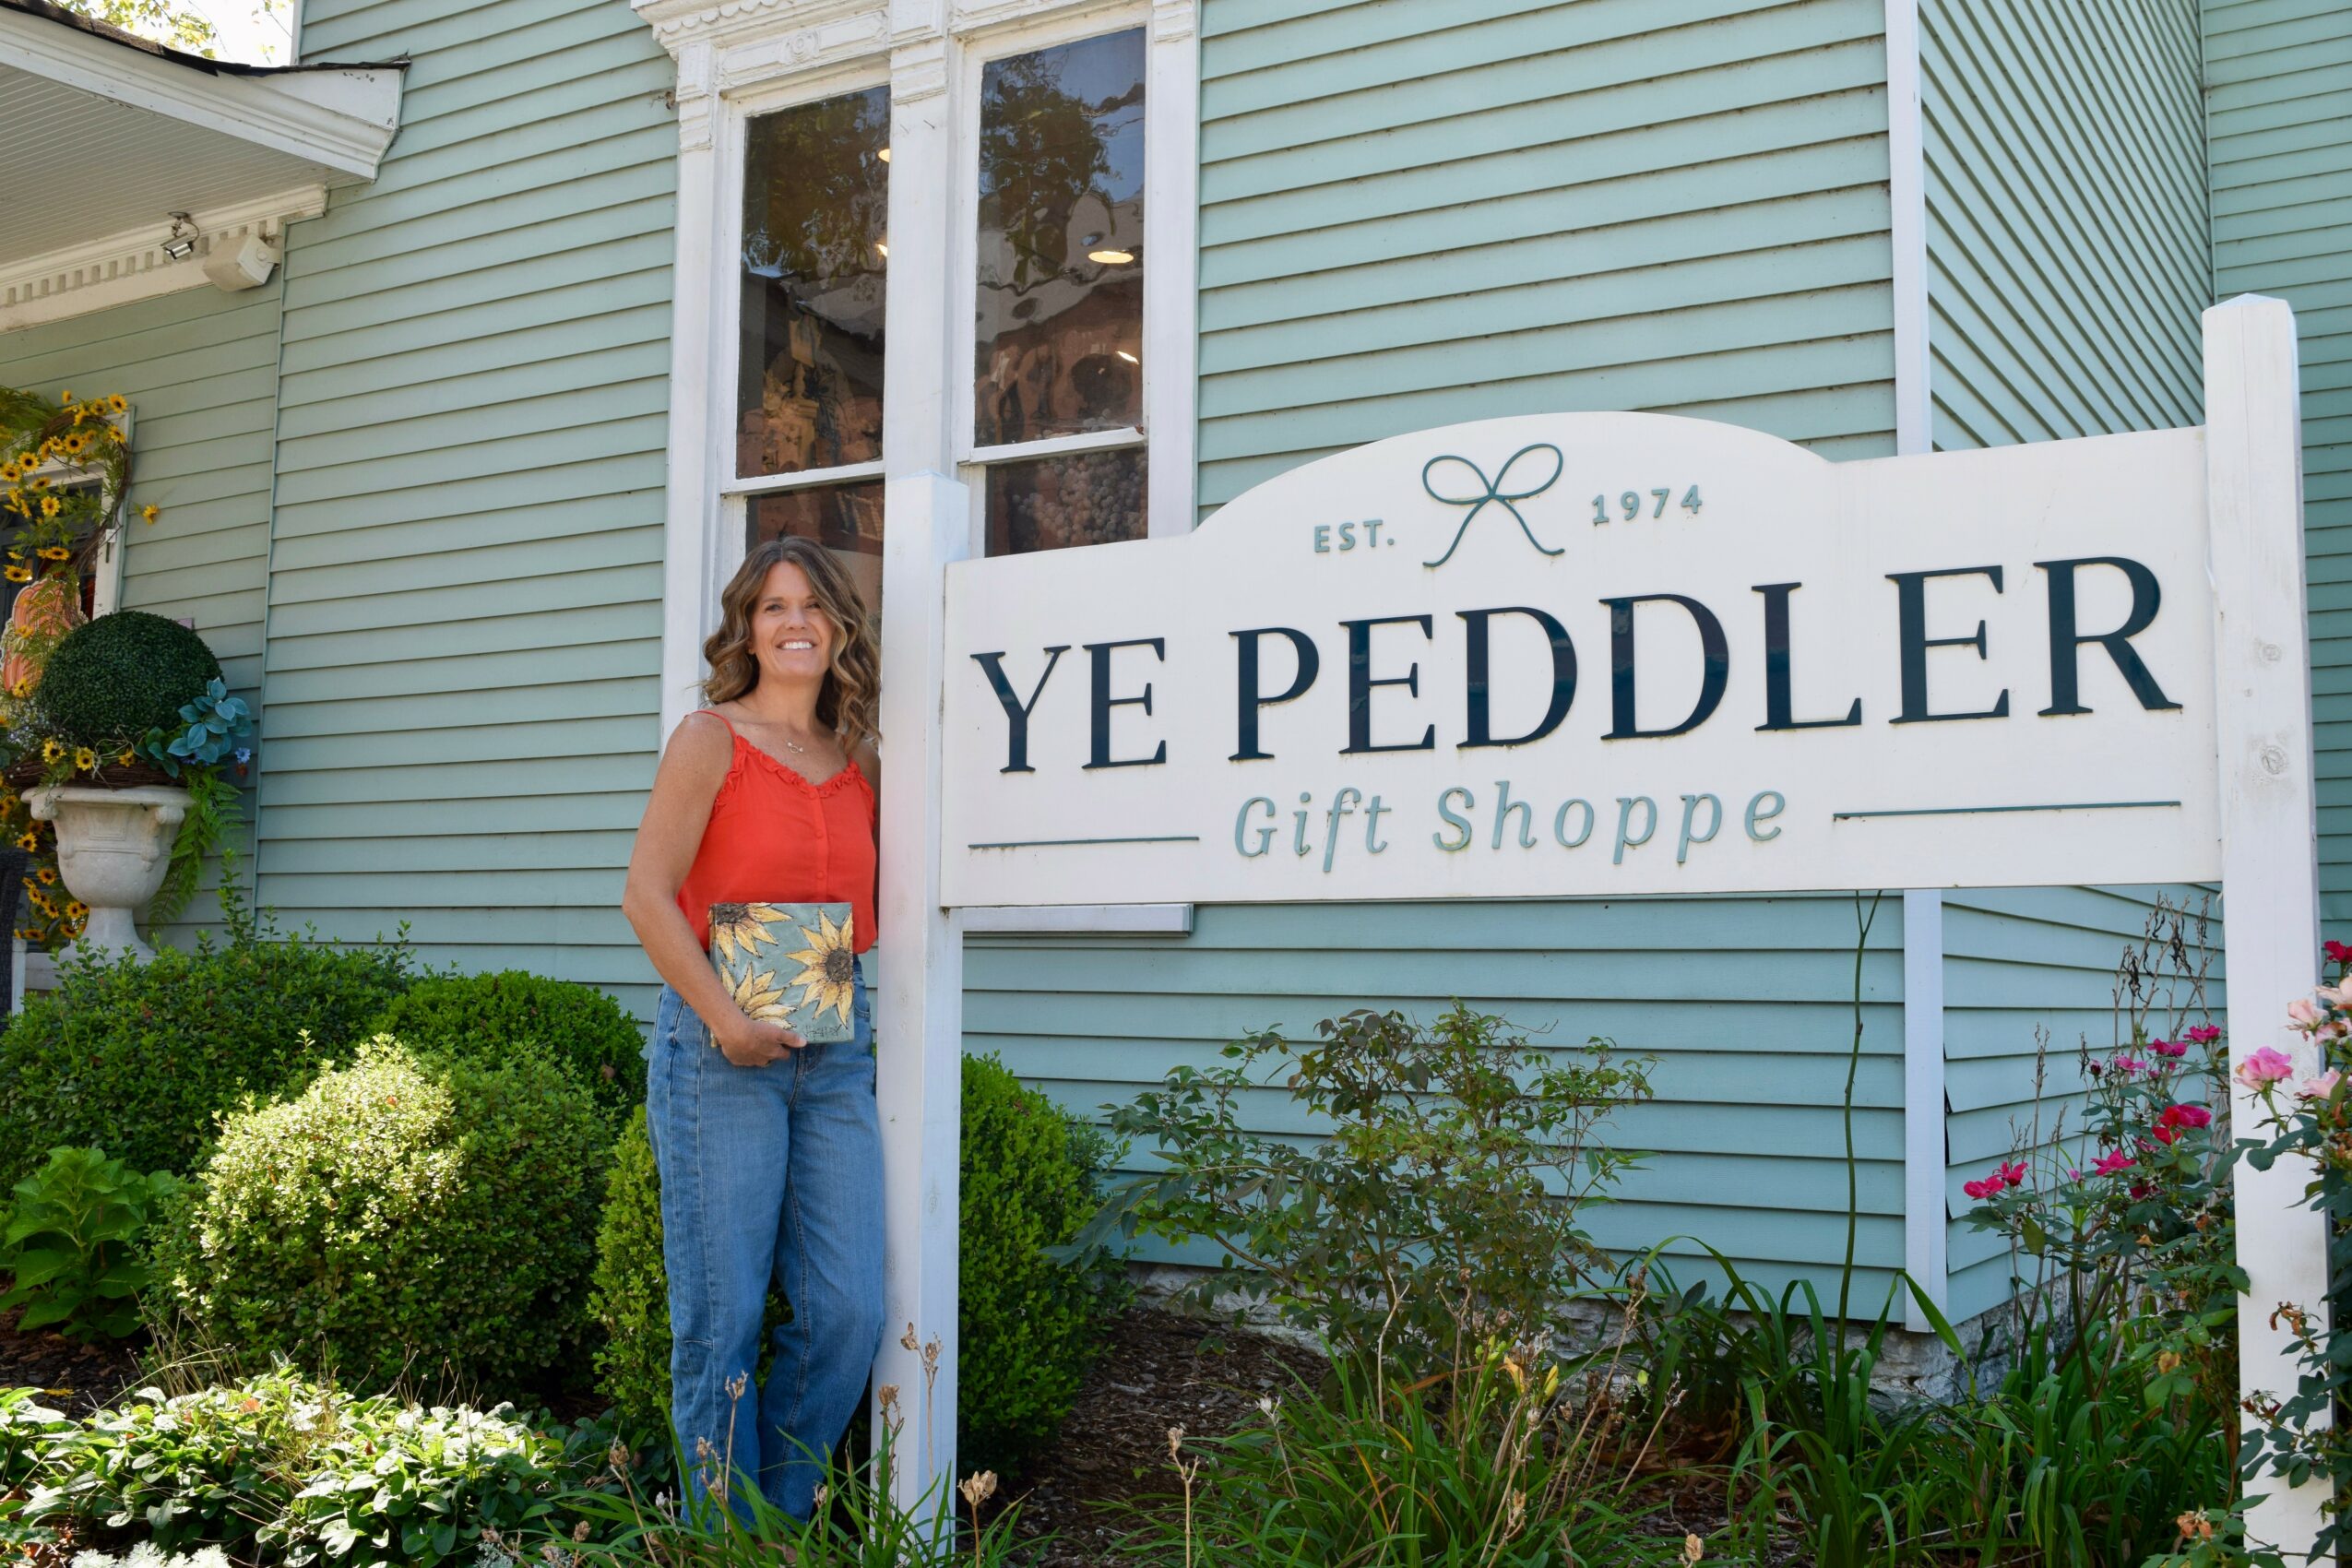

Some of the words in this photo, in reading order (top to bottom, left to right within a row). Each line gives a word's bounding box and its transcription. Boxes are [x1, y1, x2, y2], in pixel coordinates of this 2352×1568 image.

[1313, 518, 1395, 553] EST.
[1591, 484, 1703, 527] 1974
[969, 636, 1167, 774] YE
[1228, 555, 2183, 762] PEDDLER
[1234, 787, 1392, 873] Gift
[1432, 780, 1786, 865] Shoppe
